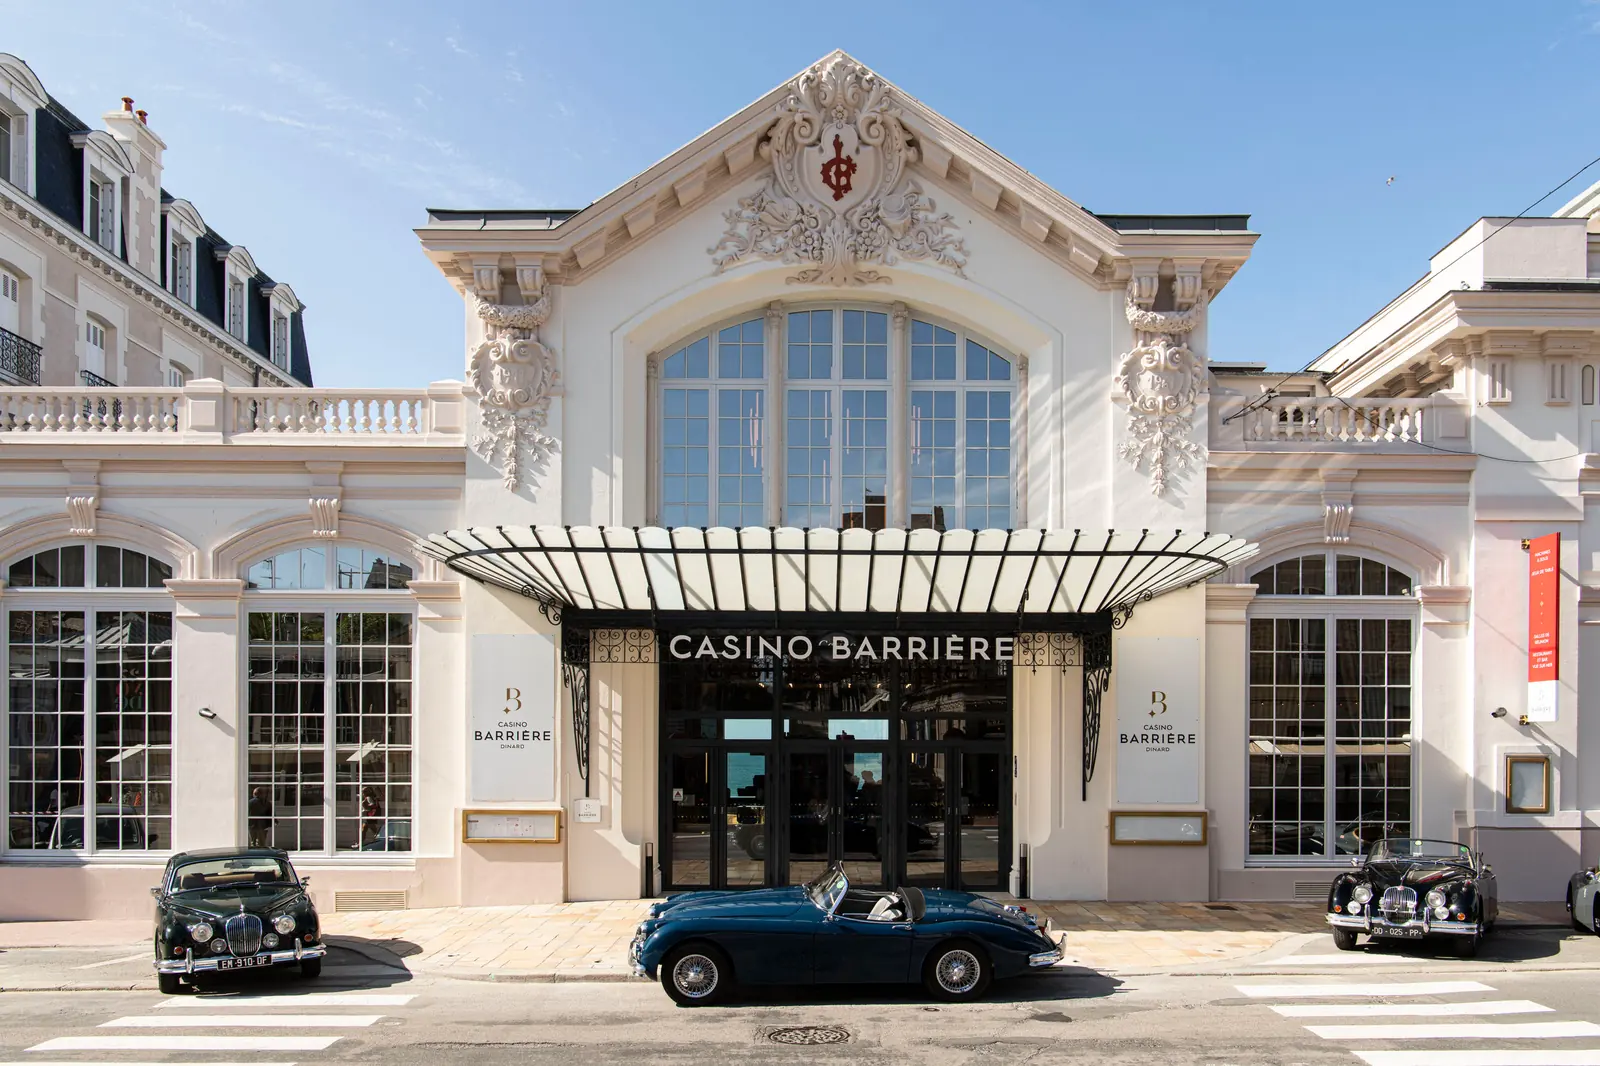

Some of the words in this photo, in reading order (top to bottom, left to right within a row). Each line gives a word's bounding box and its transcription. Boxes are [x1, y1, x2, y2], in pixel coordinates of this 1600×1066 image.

[669, 634, 813, 660] CASINO
[832, 634, 1013, 661] BARRIÈRE
[474, 729, 551, 741] BARRIÈRE
[1120, 732, 1196, 744] BARRIÈRE
